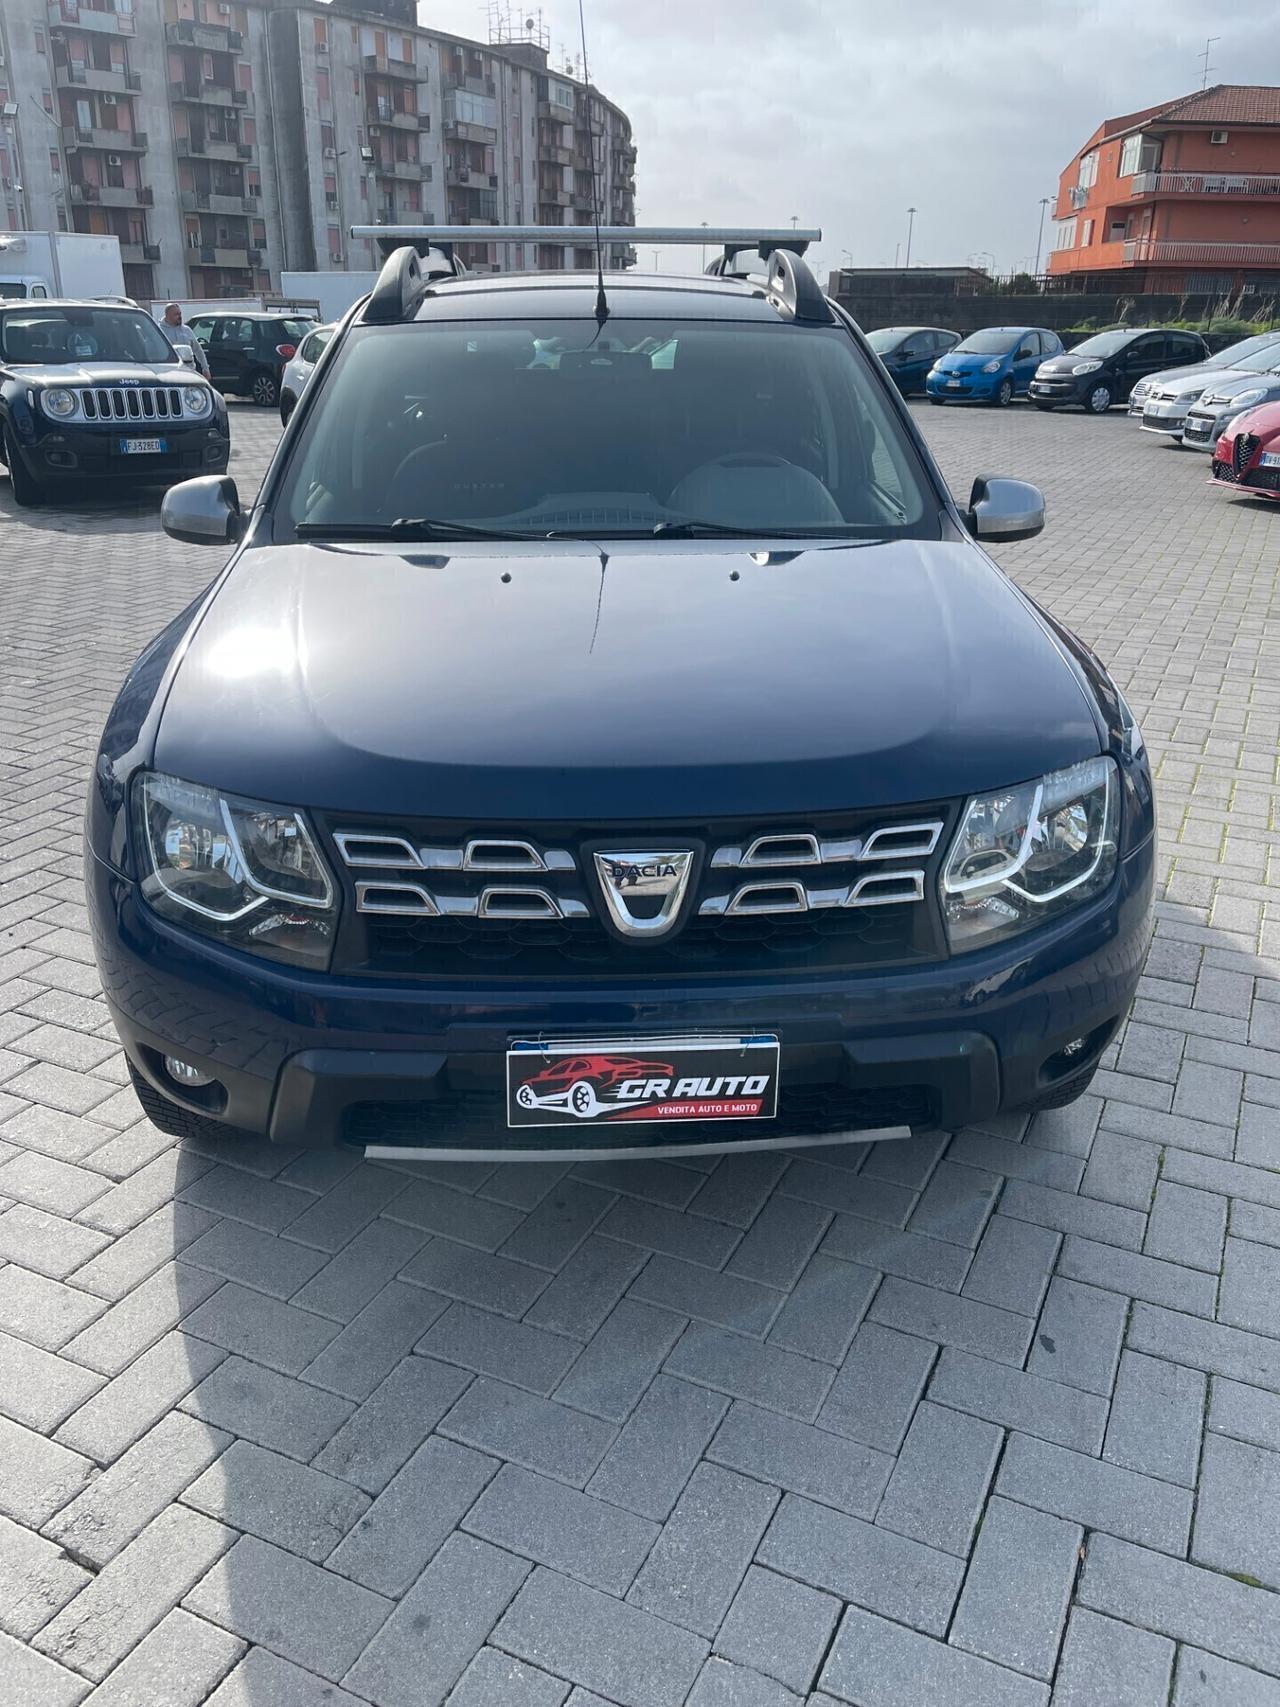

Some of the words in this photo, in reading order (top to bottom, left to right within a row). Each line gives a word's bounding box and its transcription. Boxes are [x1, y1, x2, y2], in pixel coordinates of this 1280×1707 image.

[612, 864, 677, 877] DACIA
[616, 1078, 671, 1099] GR
[672, 1075, 770, 1097] AUTO
[657, 1106, 696, 1115] VENDITA
[698, 1105, 722, 1114] AUTO
[724, 1105, 729, 1113] E
[731, 1103, 758, 1112] MOTO
